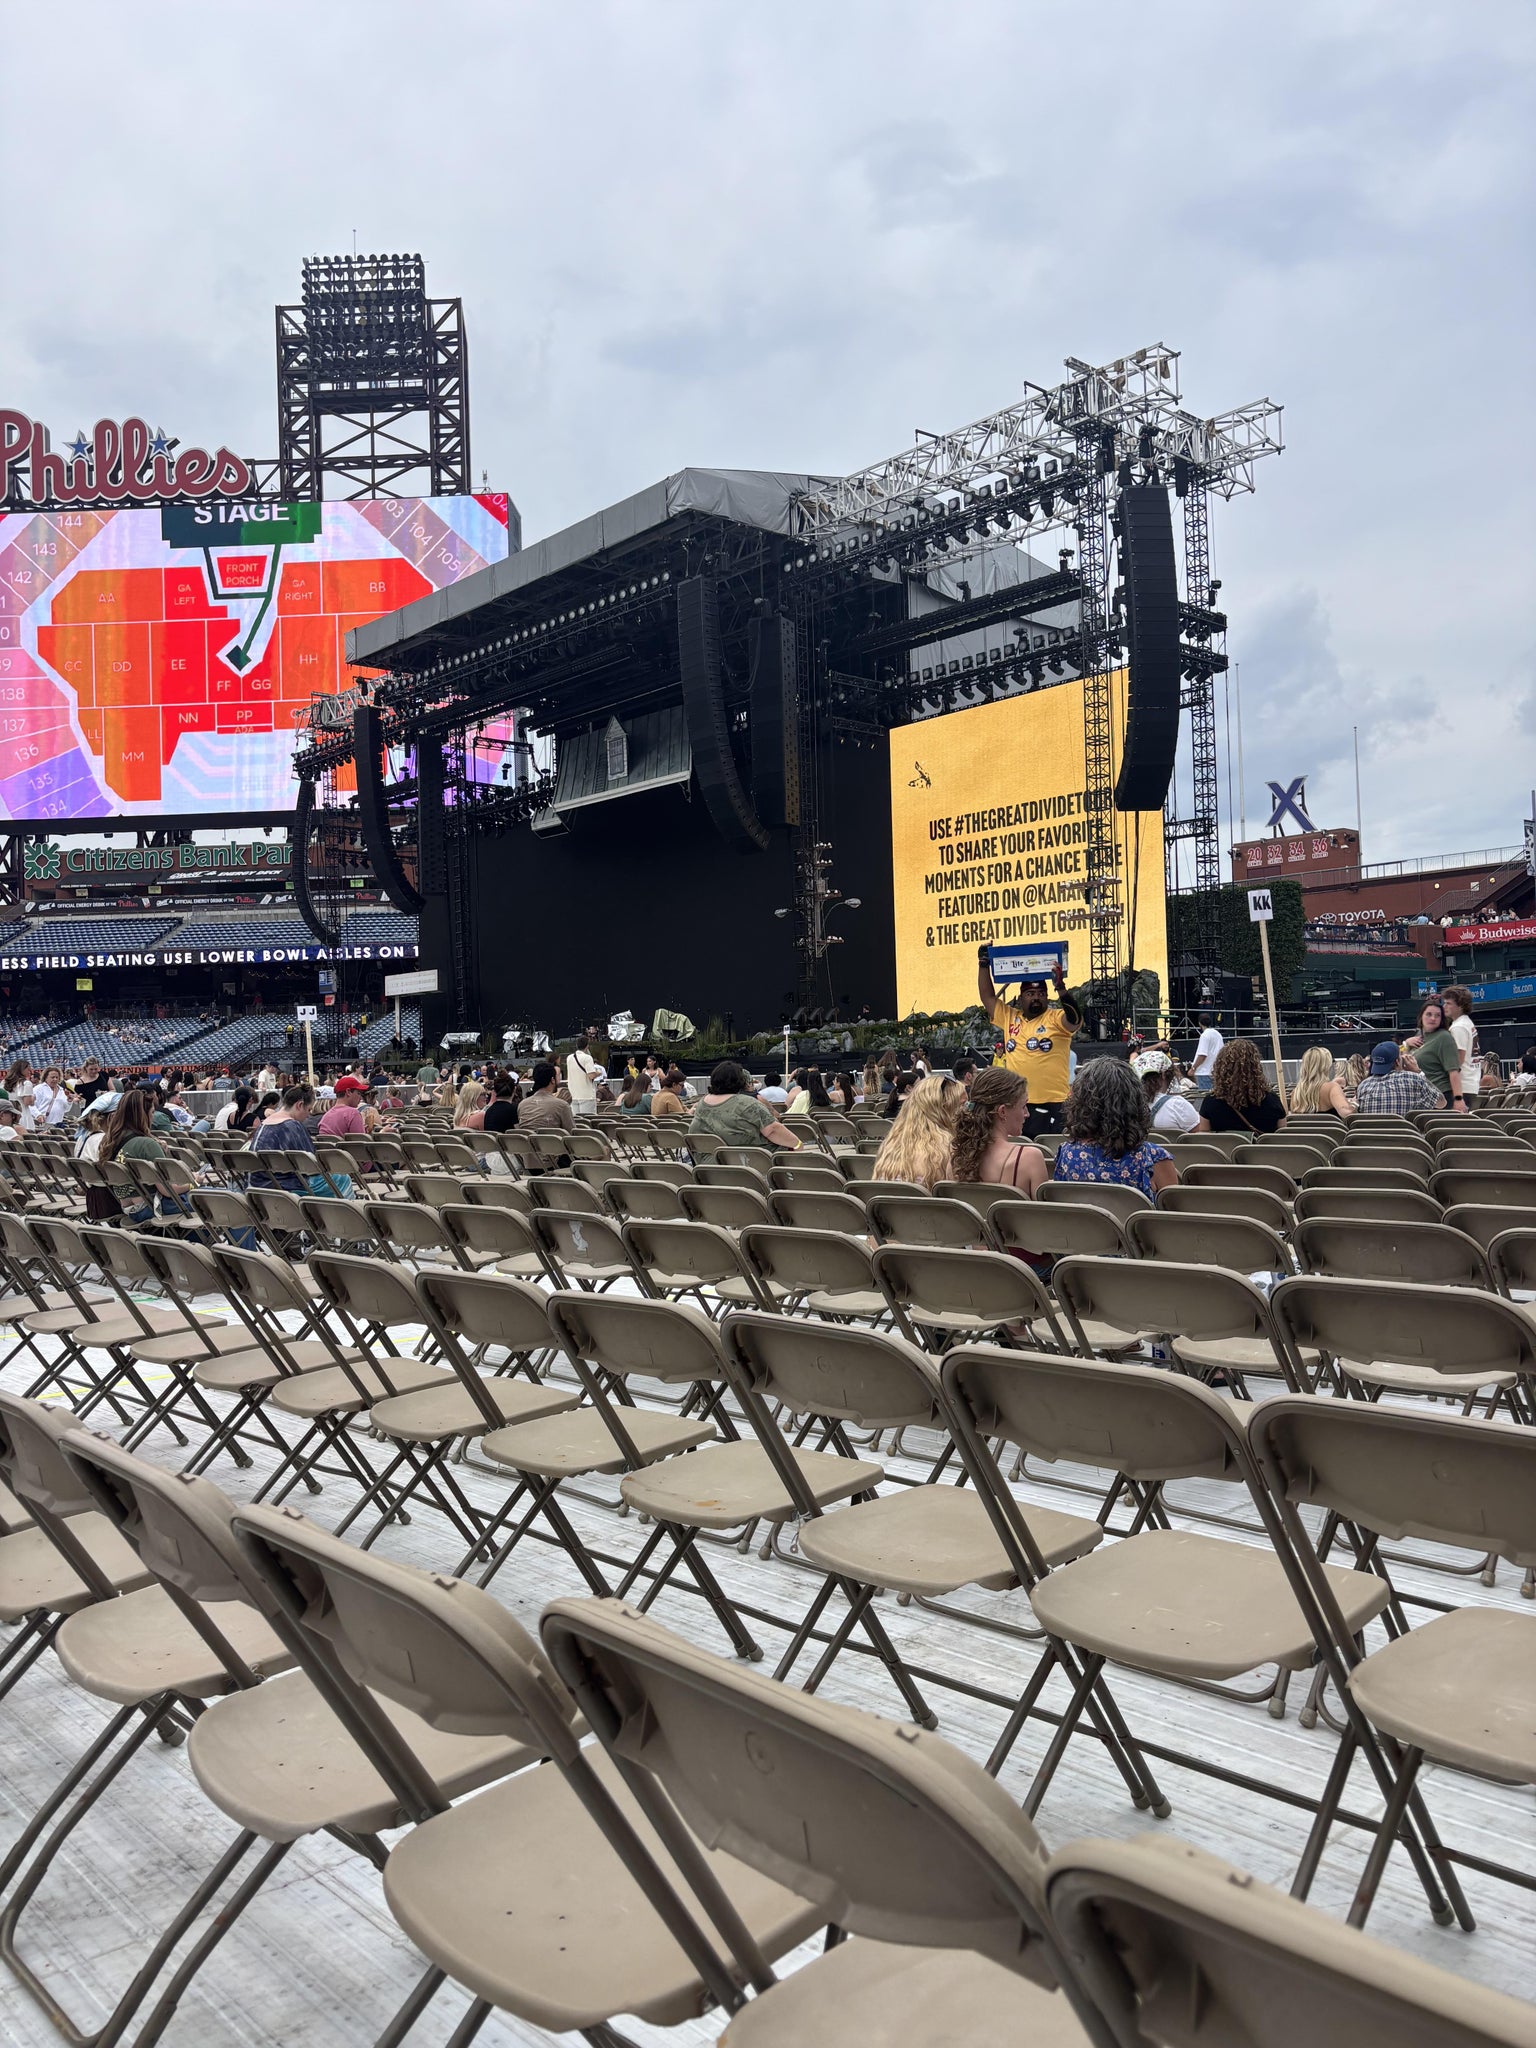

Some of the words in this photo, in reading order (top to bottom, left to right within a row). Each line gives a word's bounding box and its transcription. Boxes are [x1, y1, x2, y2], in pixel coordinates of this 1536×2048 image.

[194, 503, 290, 524] STAGE
[57, 515, 82, 528] 144
[408, 521, 433, 546] 104
[33, 542, 57, 556] 143
[436, 547, 461, 572] 105
[226, 563, 259, 573] FRONT
[8, 570, 32, 584] 142
[225, 576, 260, 586] PORCH
[178, 584, 192, 592] GA
[369, 582, 387, 593] BB
[174, 596, 197, 606] LEFT
[285, 592, 314, 600] RIGHT
[171, 659, 187, 670] EE
[299, 654, 319, 664] HH
[64, 661, 83, 671] CC
[112, 662, 132, 672] DD
[216, 680, 232, 692] FF
[251, 679, 272, 690] GG
[1, 688, 26, 700] 138
[178, 712, 199, 724] NN
[236, 710, 253, 721] PP
[3, 719, 26, 731] 137
[88, 729, 103, 740] LL
[15, 743, 39, 762] 136
[121, 752, 145, 762] MM
[29, 773, 54, 790] 135
[42, 799, 68, 817] 134
[929, 817, 952, 841] USE
[938, 844, 954, 866] TO
[956, 836, 998, 863] SHARE
[1000, 830, 1035, 856] YOUR
[1267, 844, 1282, 860] 32
[1289, 841, 1304, 856] 34
[1312, 838, 1327, 853] 36
[67, 847, 173, 872] Citizens
[180, 841, 247, 868] Bank
[251, 842, 294, 866] Par
[1248, 847, 1263, 862] 20
[924, 865, 985, 894] MOMENTS
[987, 861, 1012, 885] FOR
[1014, 859, 1024, 881] A
[1025, 850, 1081, 880] CHANCE
[938, 890, 1000, 918] FEATURED
[1002, 887, 1020, 910] ON
[1253, 895, 1272, 911] KK
[1338, 909, 1386, 922] TOYOTA
[926, 926, 935, 947] &
[936, 924, 960, 946] THE
[961, 918, 1001, 943] GREAT
[1003, 912, 1048, 938] DIVIDE
[1049, 908, 1087, 933] TOUR
[36, 956, 80, 968] FIELD
[87, 953, 156, 967] SEATING
[164, 952, 192, 964] USE
[200, 951, 255, 963] LOWER
[263, 949, 309, 961] BOWL
[317, 948, 372, 960] AISLES
[379, 946, 405, 958] ON
